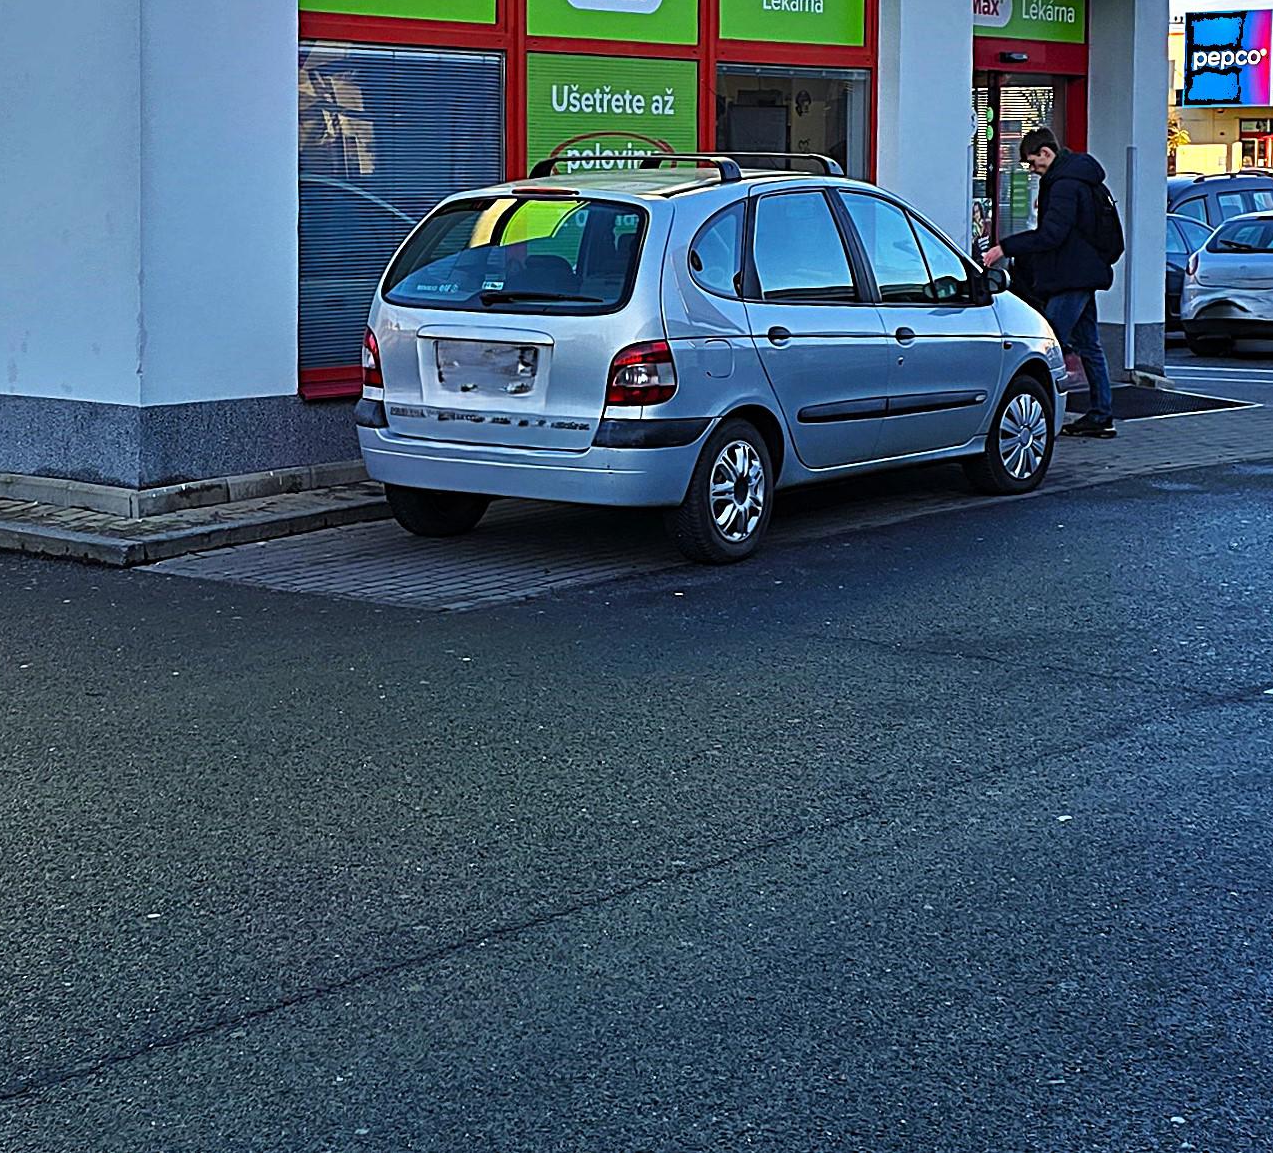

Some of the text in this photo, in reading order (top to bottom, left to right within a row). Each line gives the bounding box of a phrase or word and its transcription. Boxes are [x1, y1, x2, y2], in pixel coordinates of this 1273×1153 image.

[1192, 49, 1262, 71] pepco
[552, 83, 675, 116] Ušetřete až
